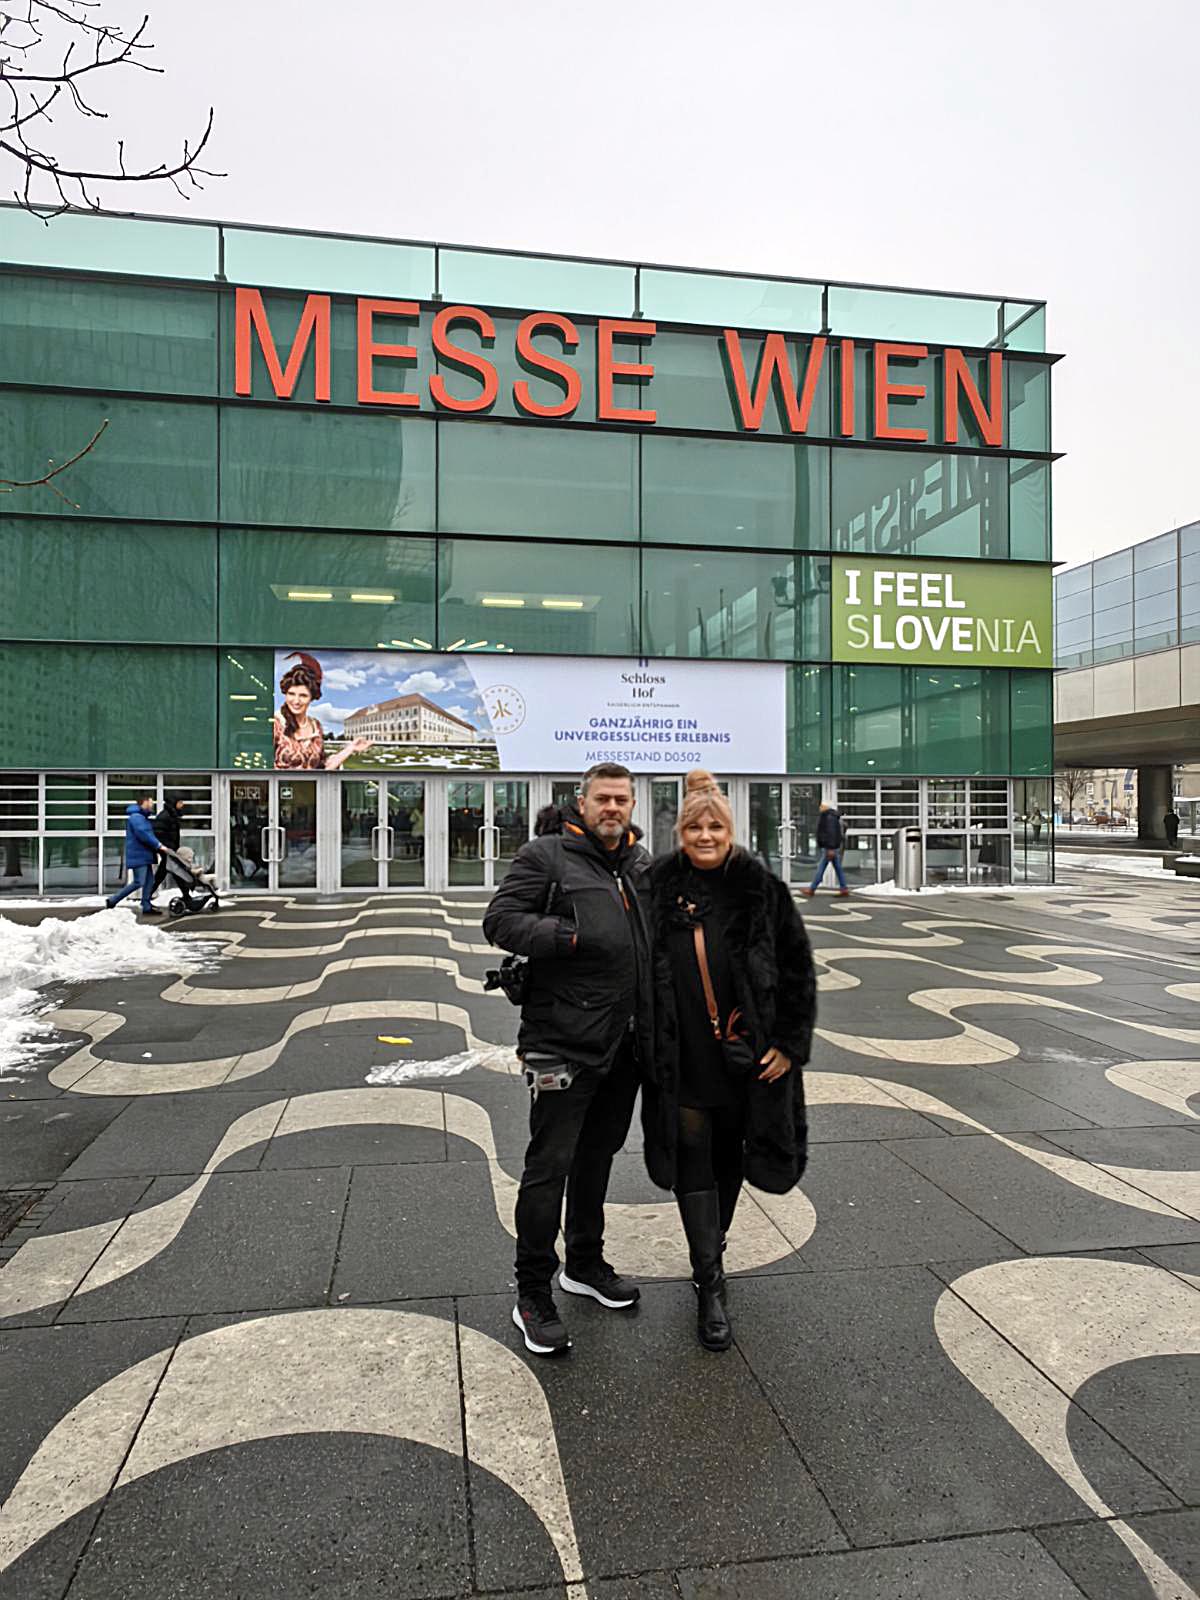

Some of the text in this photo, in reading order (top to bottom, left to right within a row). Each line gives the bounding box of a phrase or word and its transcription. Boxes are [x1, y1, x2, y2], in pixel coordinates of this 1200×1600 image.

[235, 288, 1002, 446] MESSE WIEN
[844, 569, 966, 609] I FEEL
[847, 612, 1042, 655] SLOVENIA
[621, 672, 666, 684] Schloss
[632, 687, 655, 698] Hof
[588, 715, 698, 730] GANZJÄHRIG EIN
[554, 730, 731, 744] UNVERGESSLICHES ERLEBNIS
[584, 750, 702, 763] MESSESTAND D0502
